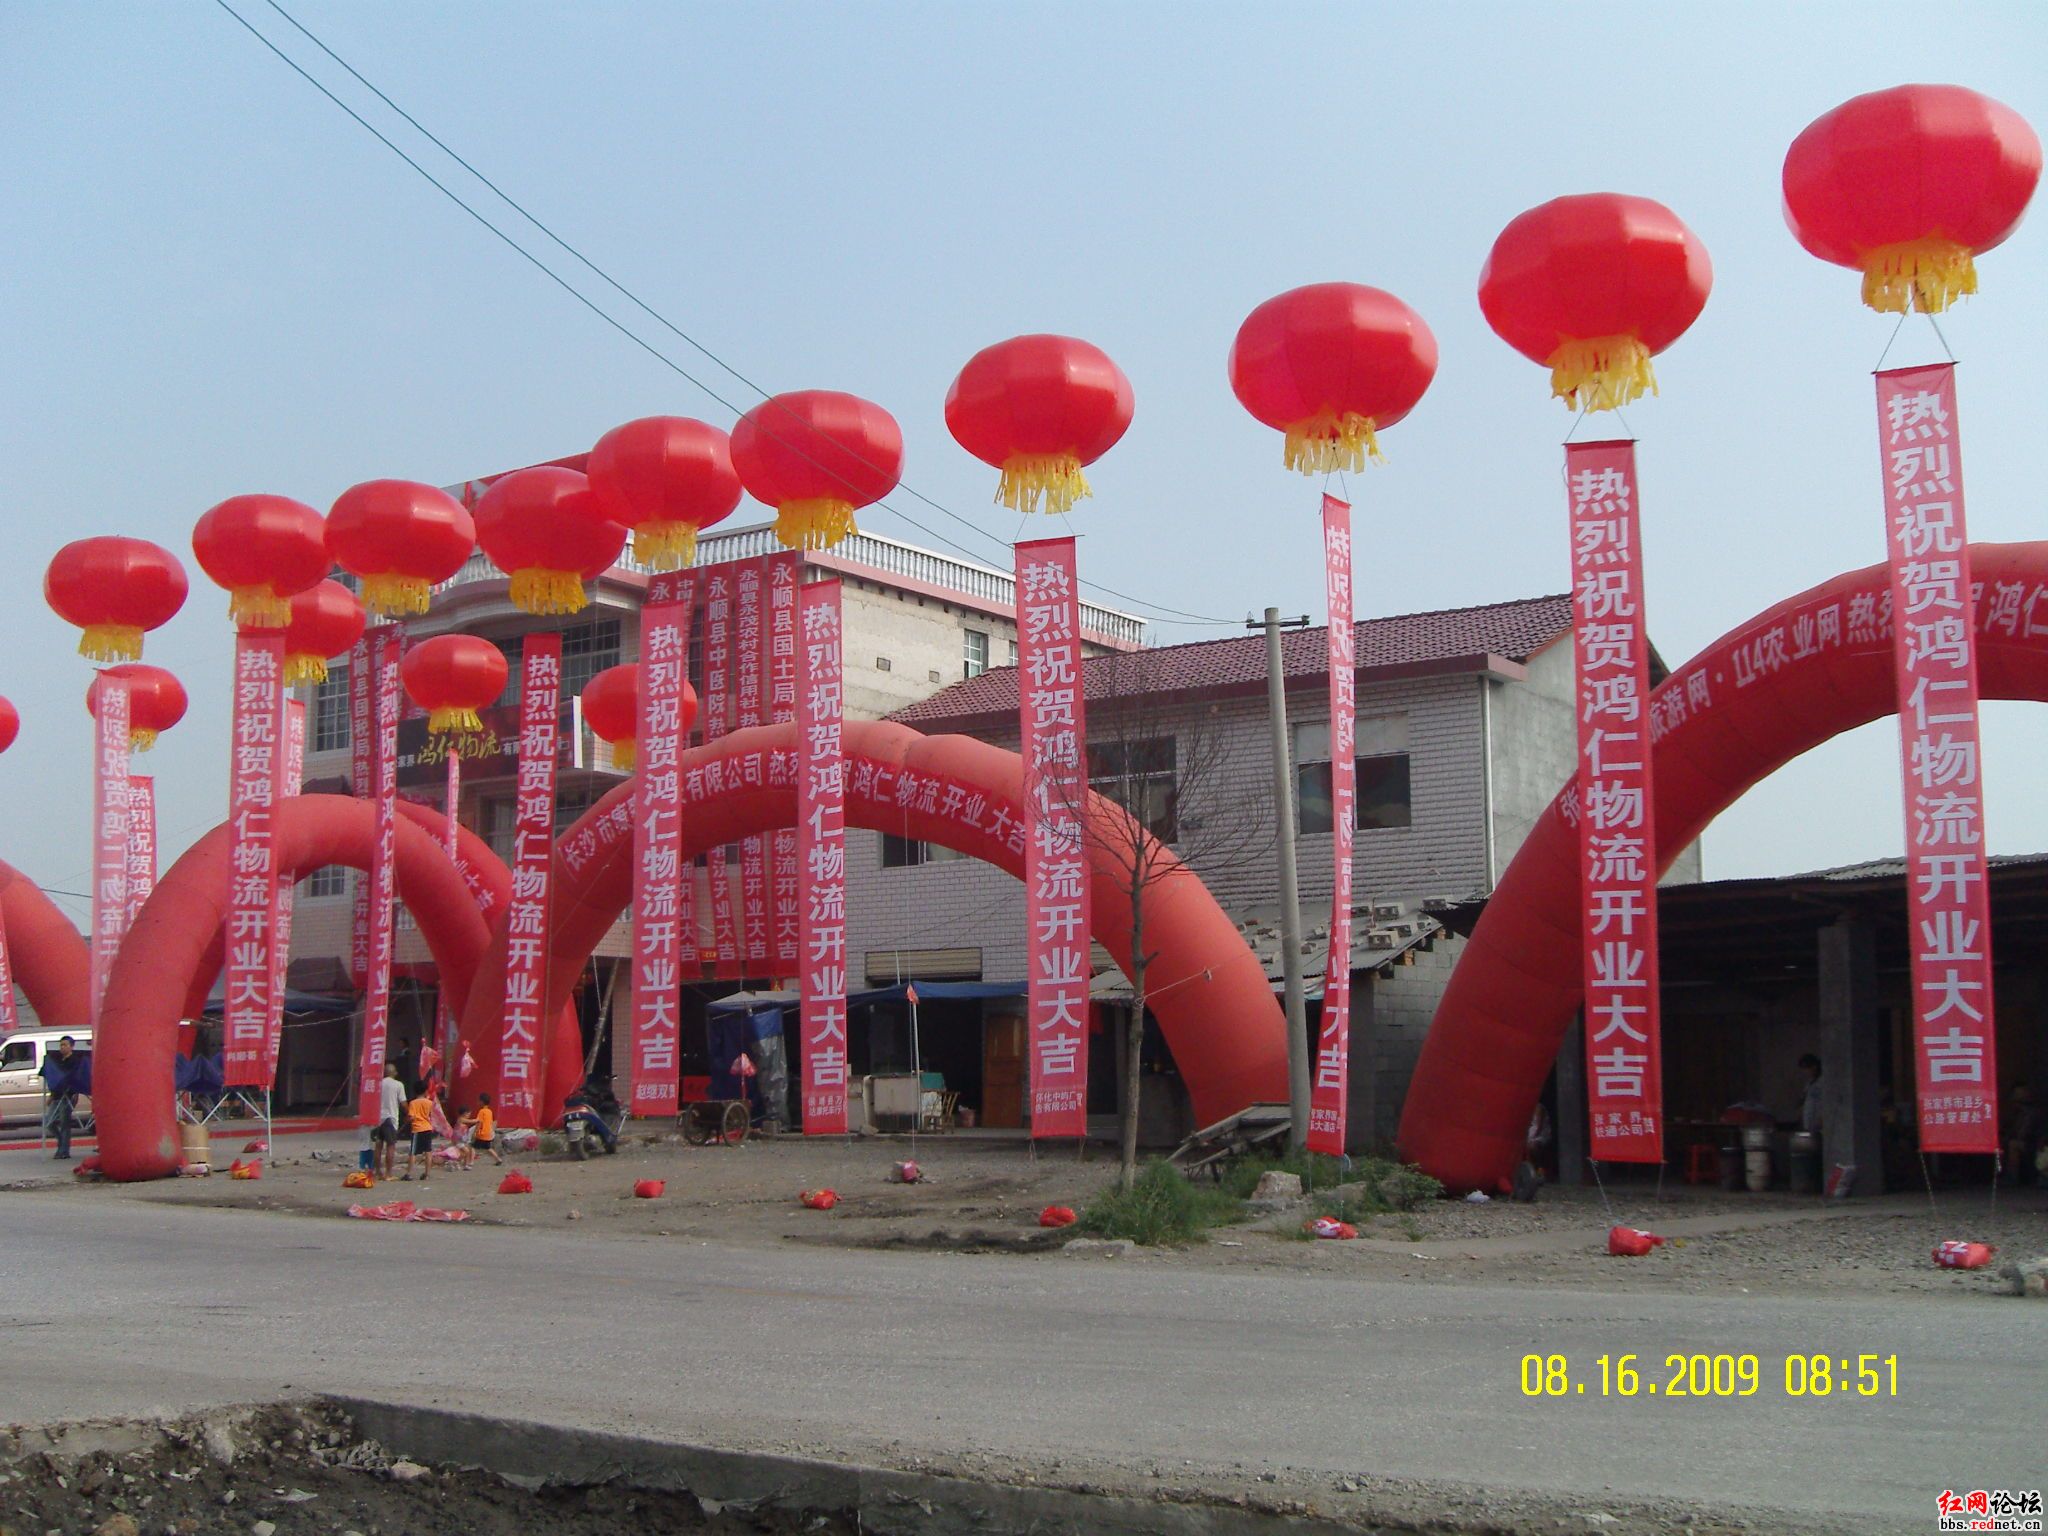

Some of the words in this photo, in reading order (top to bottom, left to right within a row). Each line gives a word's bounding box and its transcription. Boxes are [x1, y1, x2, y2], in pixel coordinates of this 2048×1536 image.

[229, 648, 276, 1039] 热烈祝贺鸿仁物流开业大吉
[501, 653, 559, 1078] 热烈祝贺鸿仁物流开业大吉
[639, 624, 682, 1069] 热烈祝贺鸿仁物流开业大吉
[803, 602, 845, 1086] 热烈祝贺鸿仁物流开业大吉
[1021, 560, 1084, 1075] 热烈祝贺鸿仁物流开业大吉
[1571, 468, 1647, 1097] 热烈祝贺鸿仁物流开业大吉
[1887, 392, 1983, 1083] 热烈祝贺鸿仁物流开业大吉
